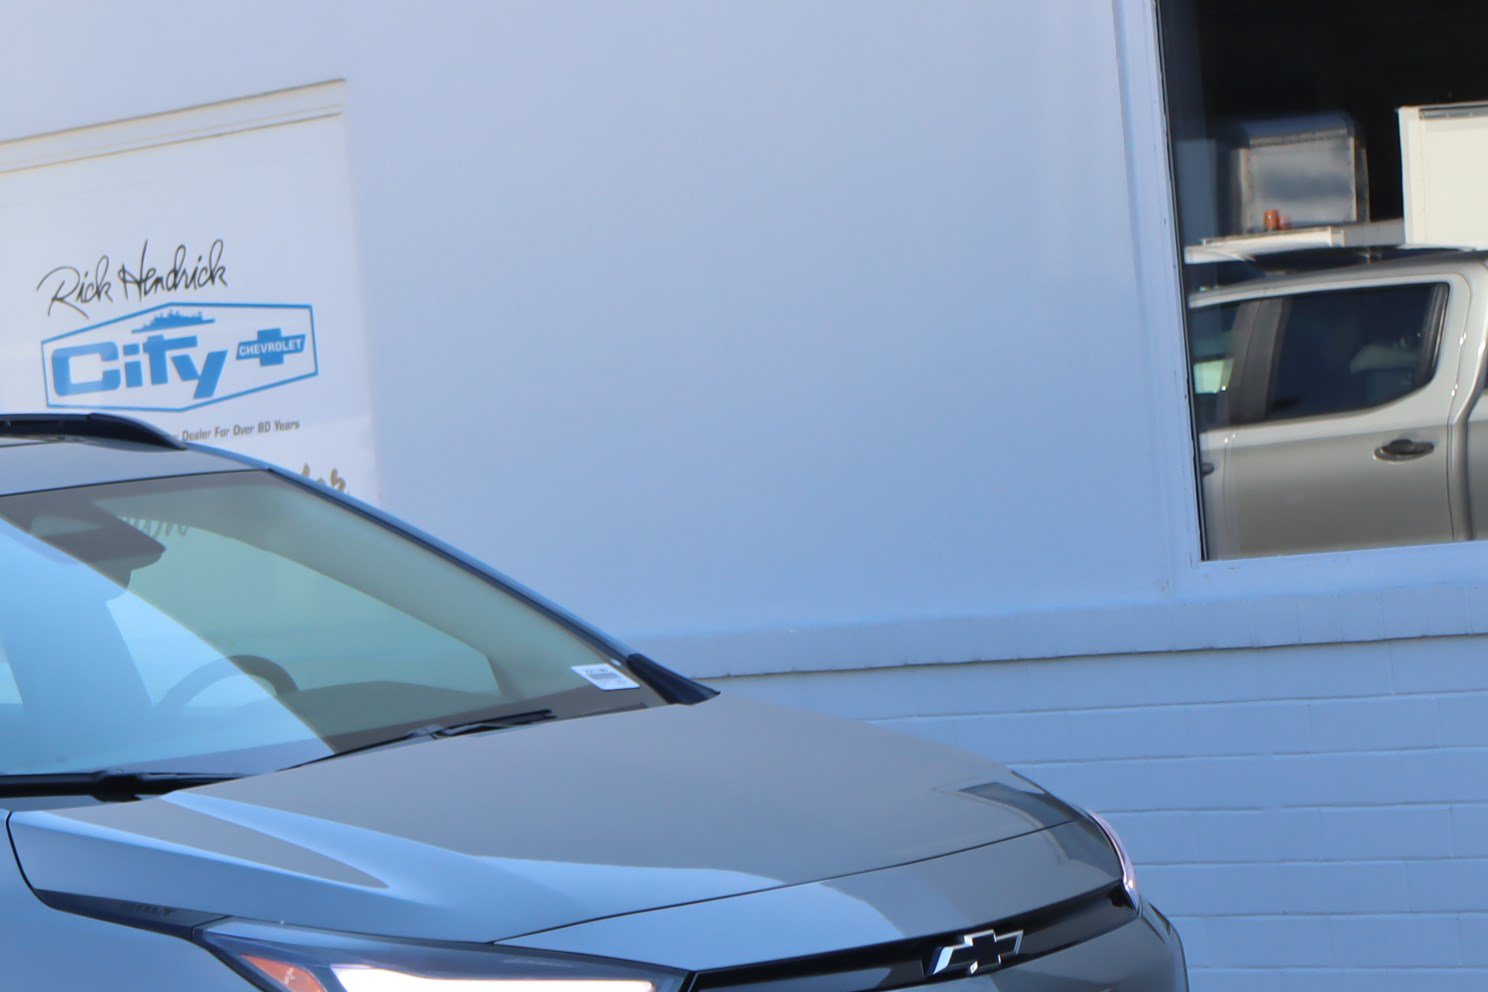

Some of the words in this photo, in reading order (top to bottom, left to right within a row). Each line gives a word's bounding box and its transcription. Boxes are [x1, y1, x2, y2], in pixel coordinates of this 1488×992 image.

[36, 255, 113, 320] Rick
[117, 239, 228, 302] Hendrick
[52, 334, 228, 399] City
[239, 338, 303, 356] CHEVROLET
[182, 429, 212, 441] Dealer
[214, 426, 231, 438] For
[233, 423, 255, 436] Over
[257, 420, 272, 433] 80
[274, 419, 301, 431] Years
